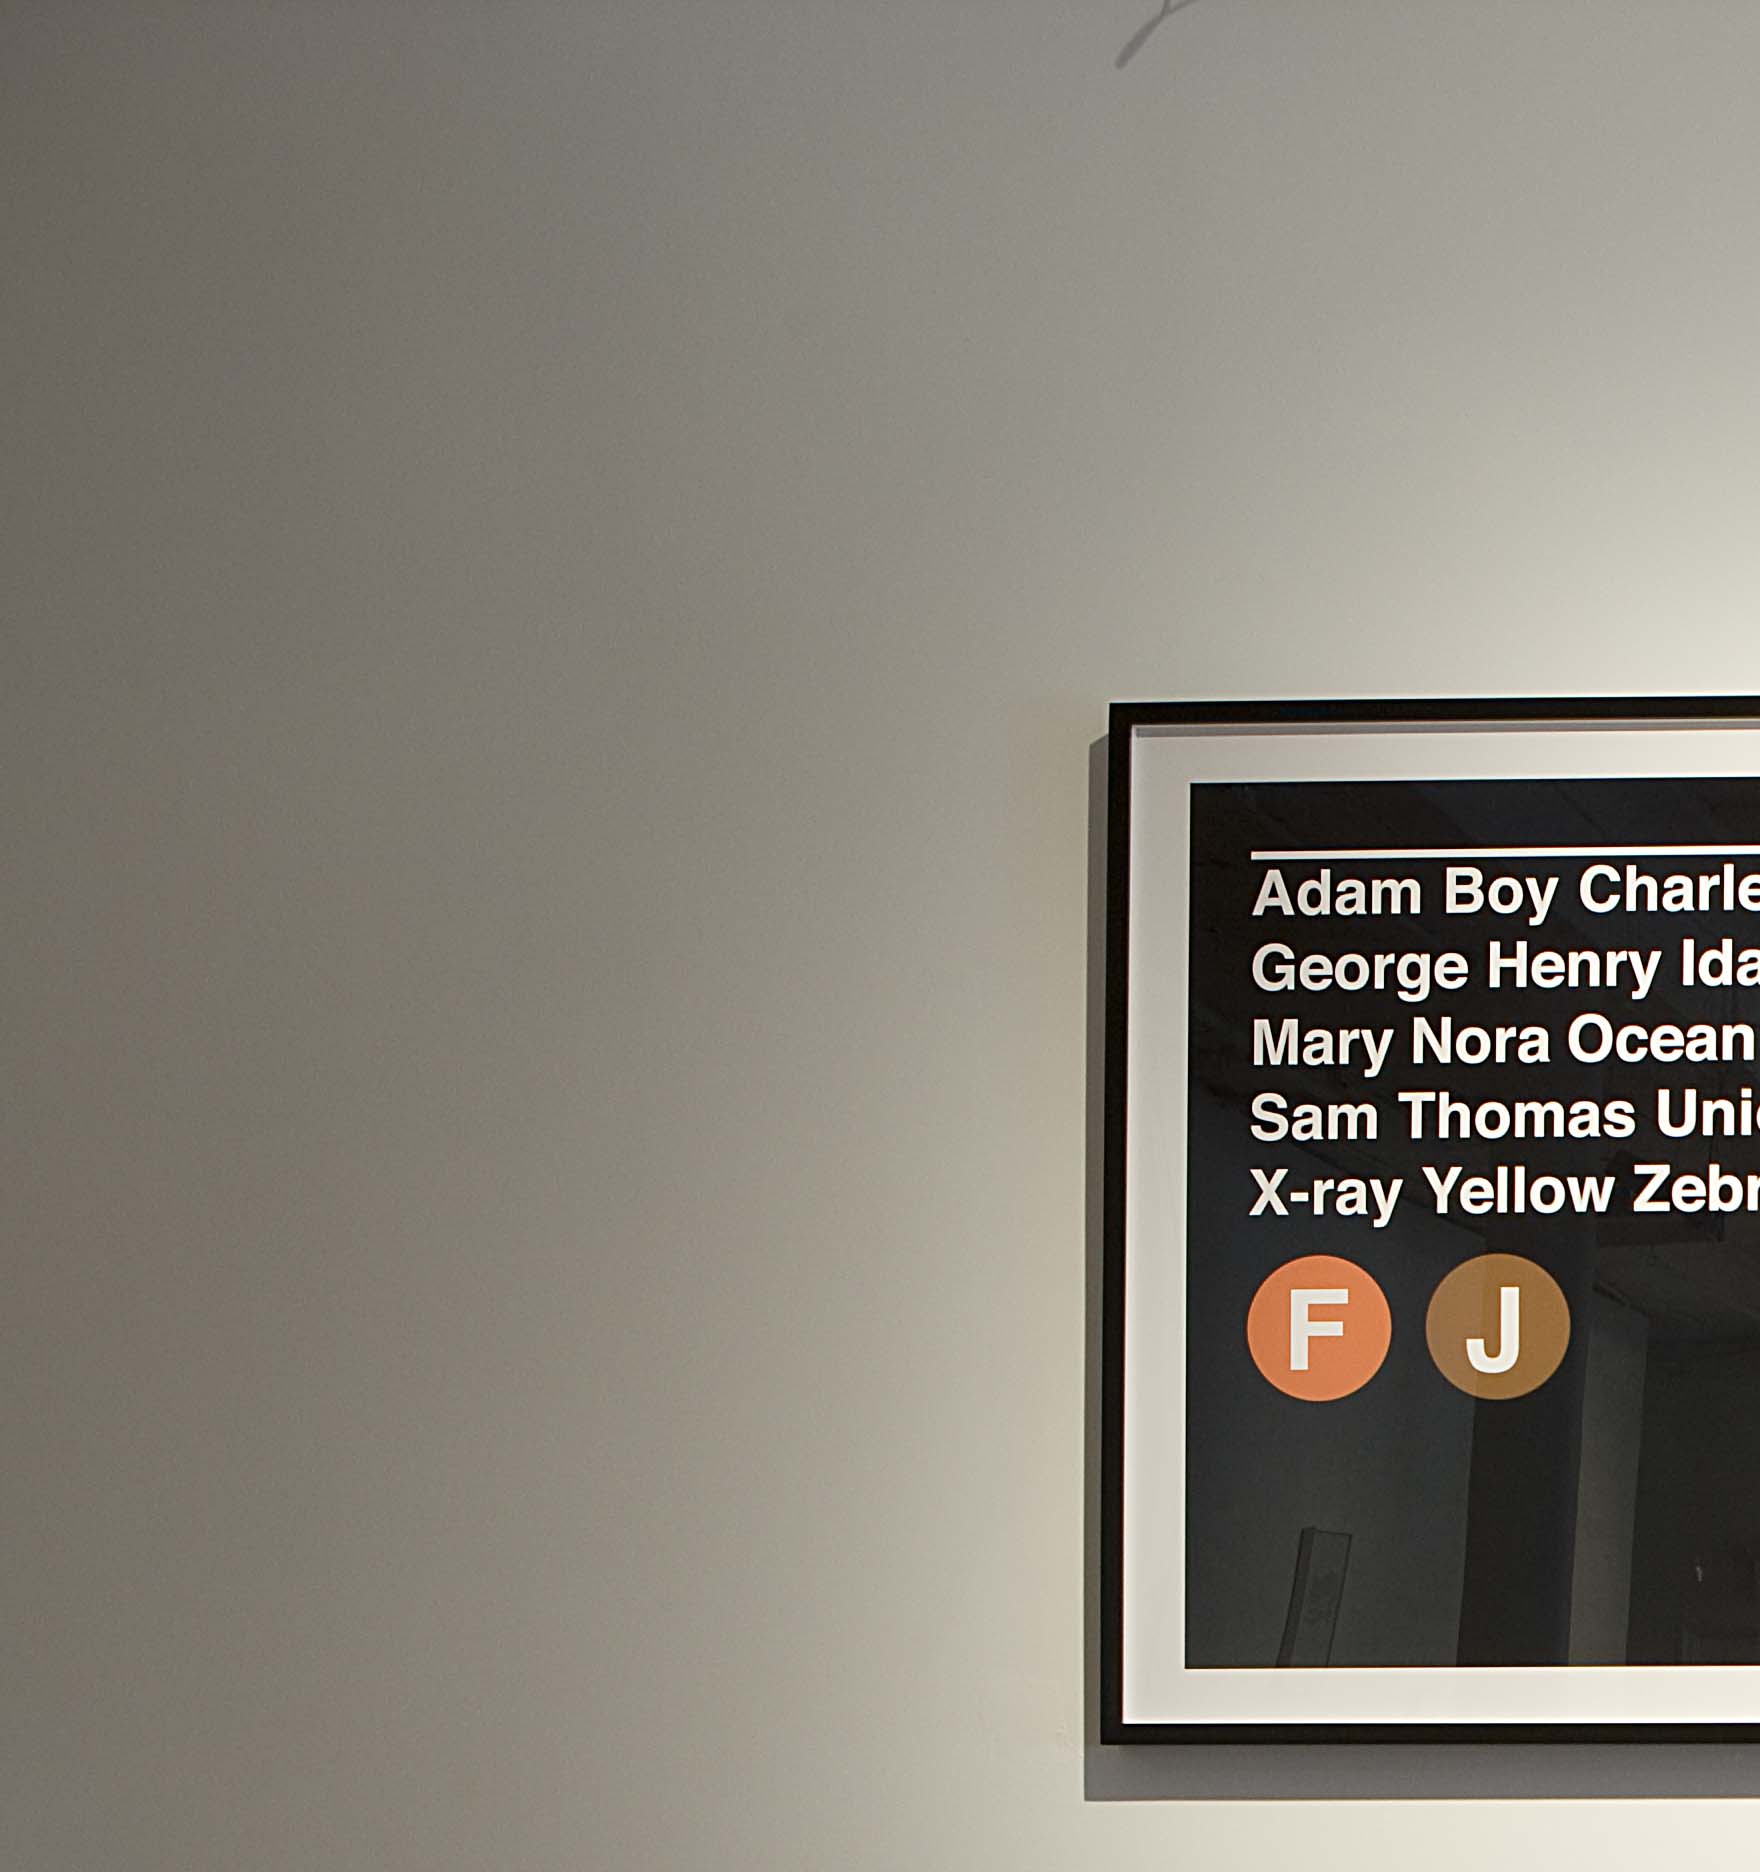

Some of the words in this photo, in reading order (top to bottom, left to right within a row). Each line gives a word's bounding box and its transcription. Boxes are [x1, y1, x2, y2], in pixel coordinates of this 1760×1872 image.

[1251, 867, 1422, 917] Adam
[1444, 865, 1561, 927] Boy
[1251, 942, 1470, 1004] George
[1488, 939, 1663, 1001] Henry
[1252, 1017, 1396, 1079] Mary
[1412, 1015, 1552, 1065] Nora
[1567, 1012, 1756, 1064] Ocean
[1249, 1091, 1379, 1143] Sam
[1396, 1090, 1637, 1140] Thomas
[1248, 1167, 1405, 1229] X-ray
[1420, 1164, 1617, 1216] Yellow
[1289, 1287, 1350, 1372] F
[1465, 1285, 1521, 1375] J
